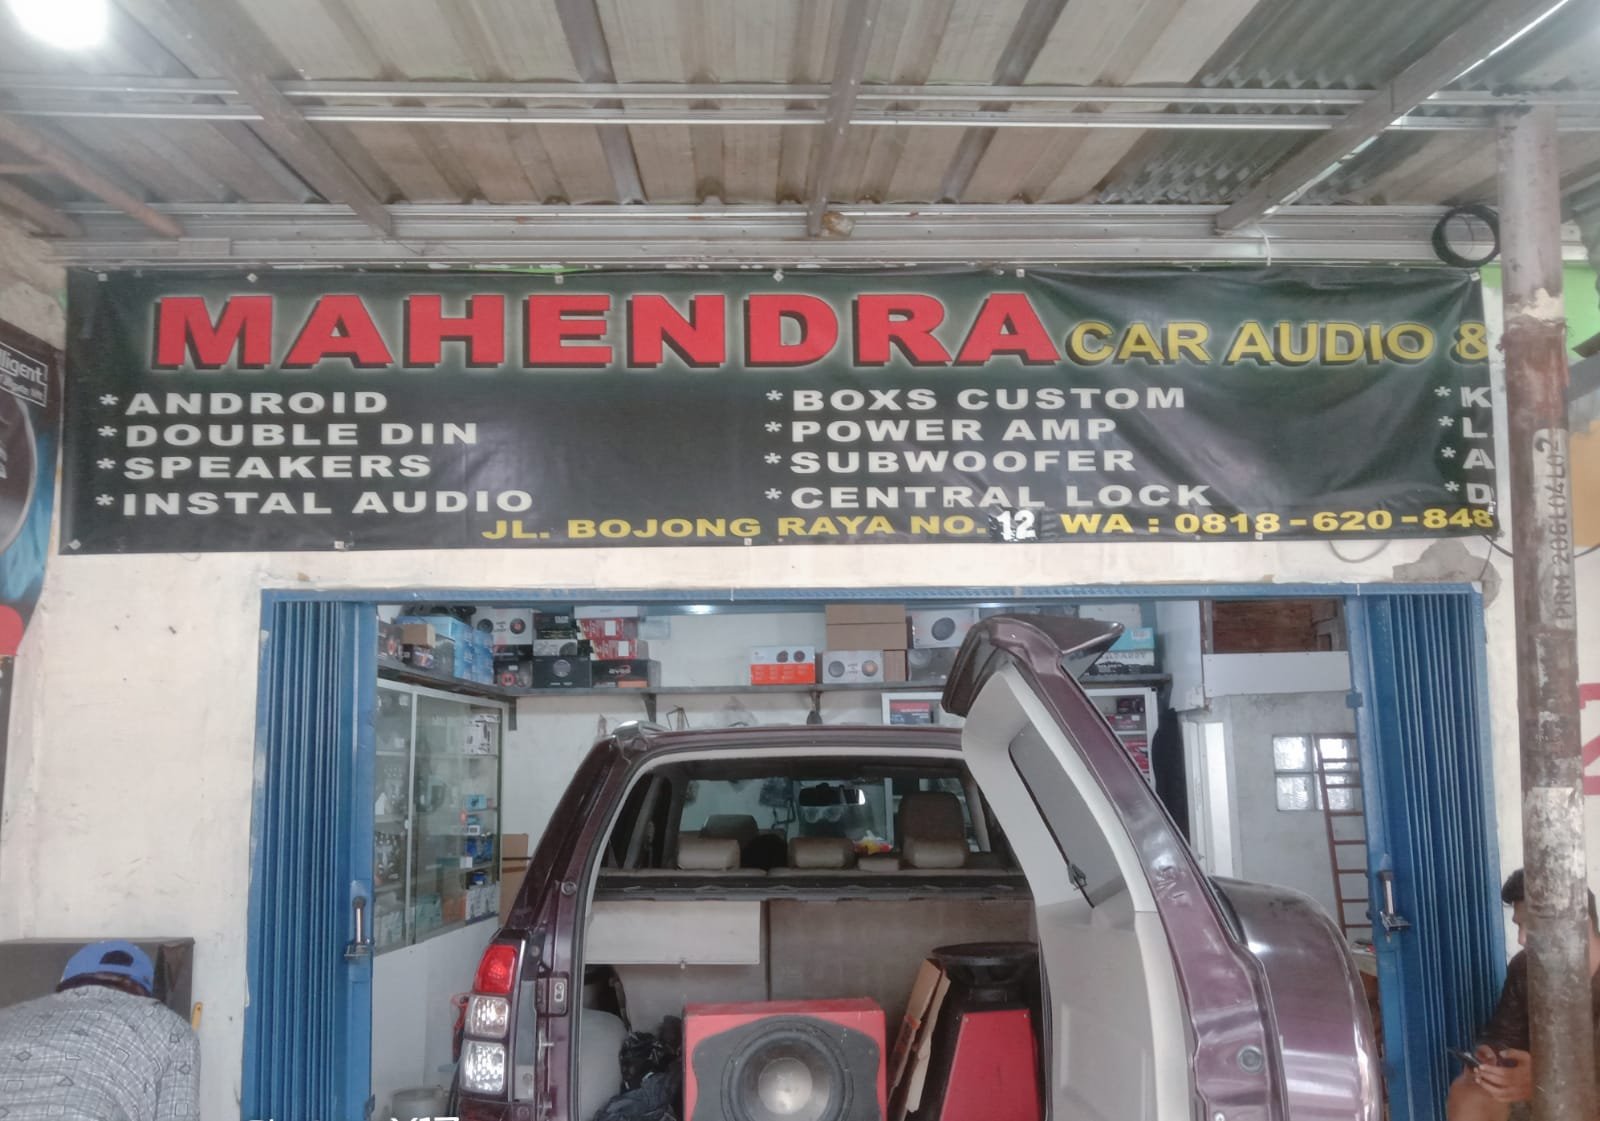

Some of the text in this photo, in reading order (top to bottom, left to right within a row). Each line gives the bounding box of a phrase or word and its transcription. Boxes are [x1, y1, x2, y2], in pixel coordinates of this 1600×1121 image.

[153, 292, 1489, 369] MAHENDRA CAR AUDIO &
[125, 391, 388, 415] ANDROID
[793, 386, 1185, 412] BOXS CUSTOM
[126, 422, 478, 447] DOUBLE DIN
[791, 418, 1117, 443] POWER AMP
[124, 454, 432, 479] SPEAKERS
[790, 449, 1137, 474] SUBWOOFER
[122, 489, 534, 516] INSTAL AUDIO
[790, 483, 1212, 511] CENTRAL LOCK
[481, 520, 549, 541] JL.
[567, 518, 761, 540] BOJONG
[778, 516, 893, 538] RAYA
[1060, 513, 1133, 535] WA
